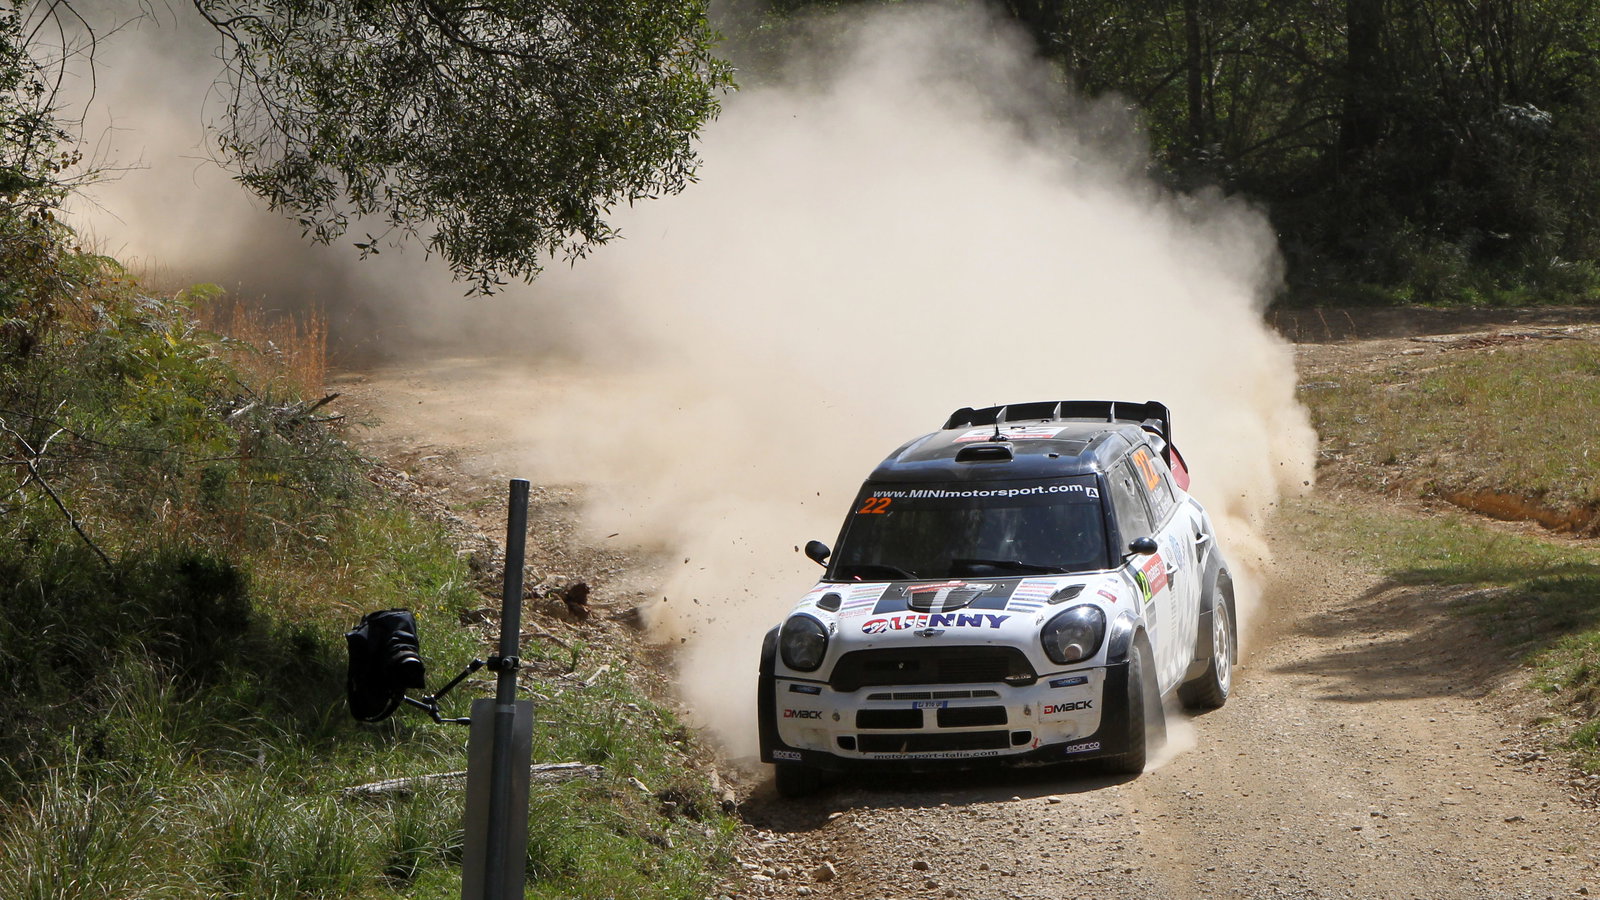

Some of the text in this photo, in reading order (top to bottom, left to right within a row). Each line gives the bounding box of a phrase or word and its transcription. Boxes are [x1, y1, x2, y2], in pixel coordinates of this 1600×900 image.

[1134, 449, 1160, 491] 22
[872, 483, 1083, 499] www.MINImotorsport.com
[858, 498, 892, 514] 22
[863, 613, 1011, 635] QUINNY
[772, 749, 802, 760] sparco
[1066, 741, 1101, 752] sparco
